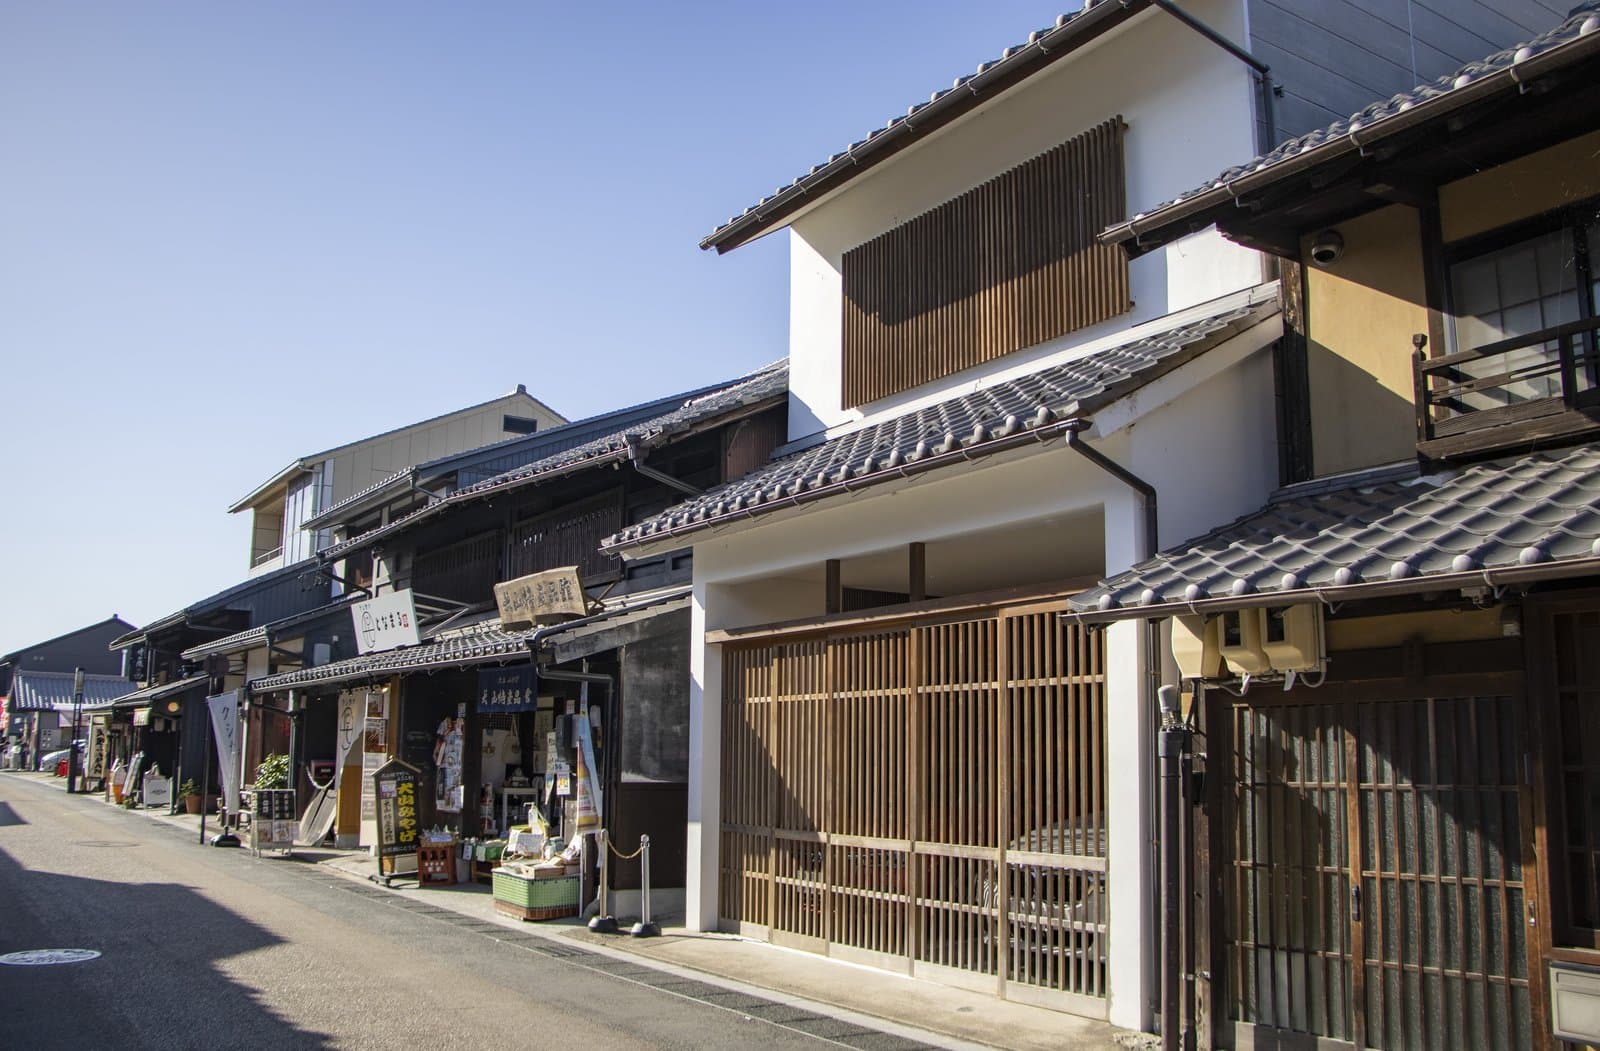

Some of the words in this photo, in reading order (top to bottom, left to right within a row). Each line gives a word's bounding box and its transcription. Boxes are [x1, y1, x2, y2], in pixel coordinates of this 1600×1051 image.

[397, 782, 417, 842] 犬山みやげ
